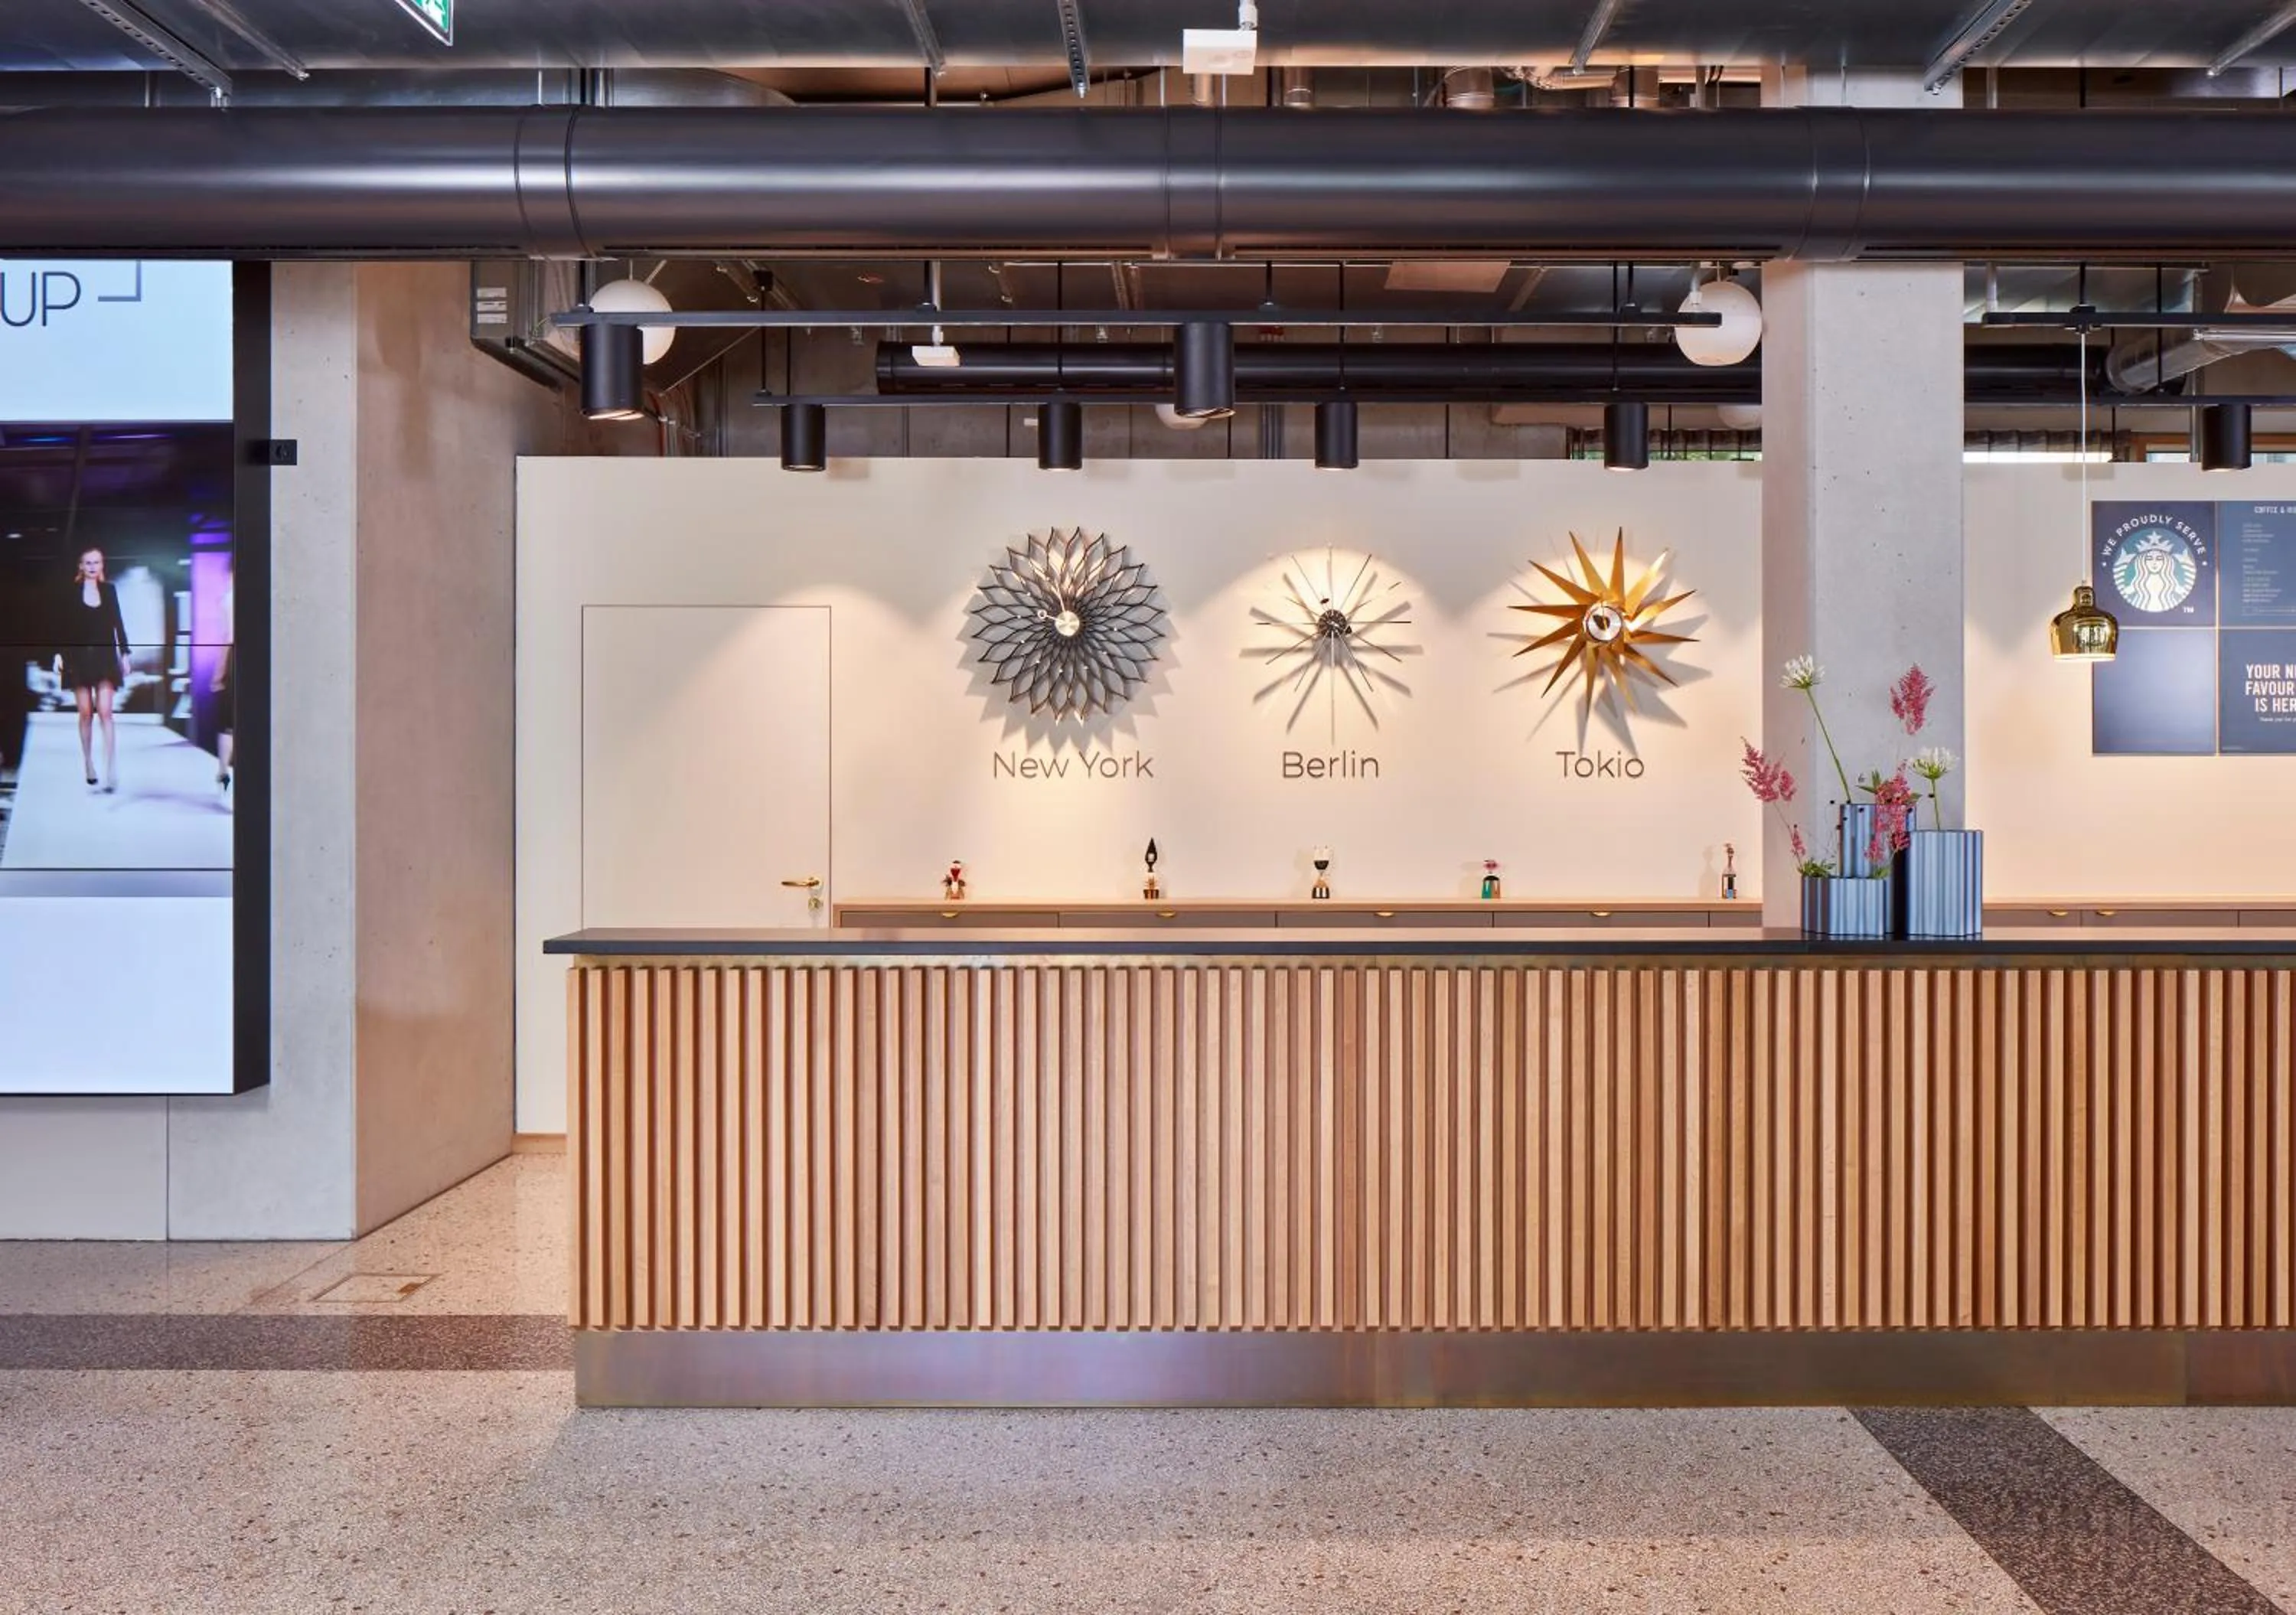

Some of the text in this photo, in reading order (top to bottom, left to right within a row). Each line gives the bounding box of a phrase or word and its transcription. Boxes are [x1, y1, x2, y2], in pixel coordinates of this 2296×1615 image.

[2100, 514, 2206, 556] WE PROUDLY SERVE
[2245, 664, 2281, 679] YOUR
[2245, 680, 2294, 695] FAVOUR
[2255, 697, 2268, 713] IS
[993, 750, 1154, 779] New York
[1282, 749, 1379, 779] Berlin
[1554, 749, 1645, 779] Tokio
